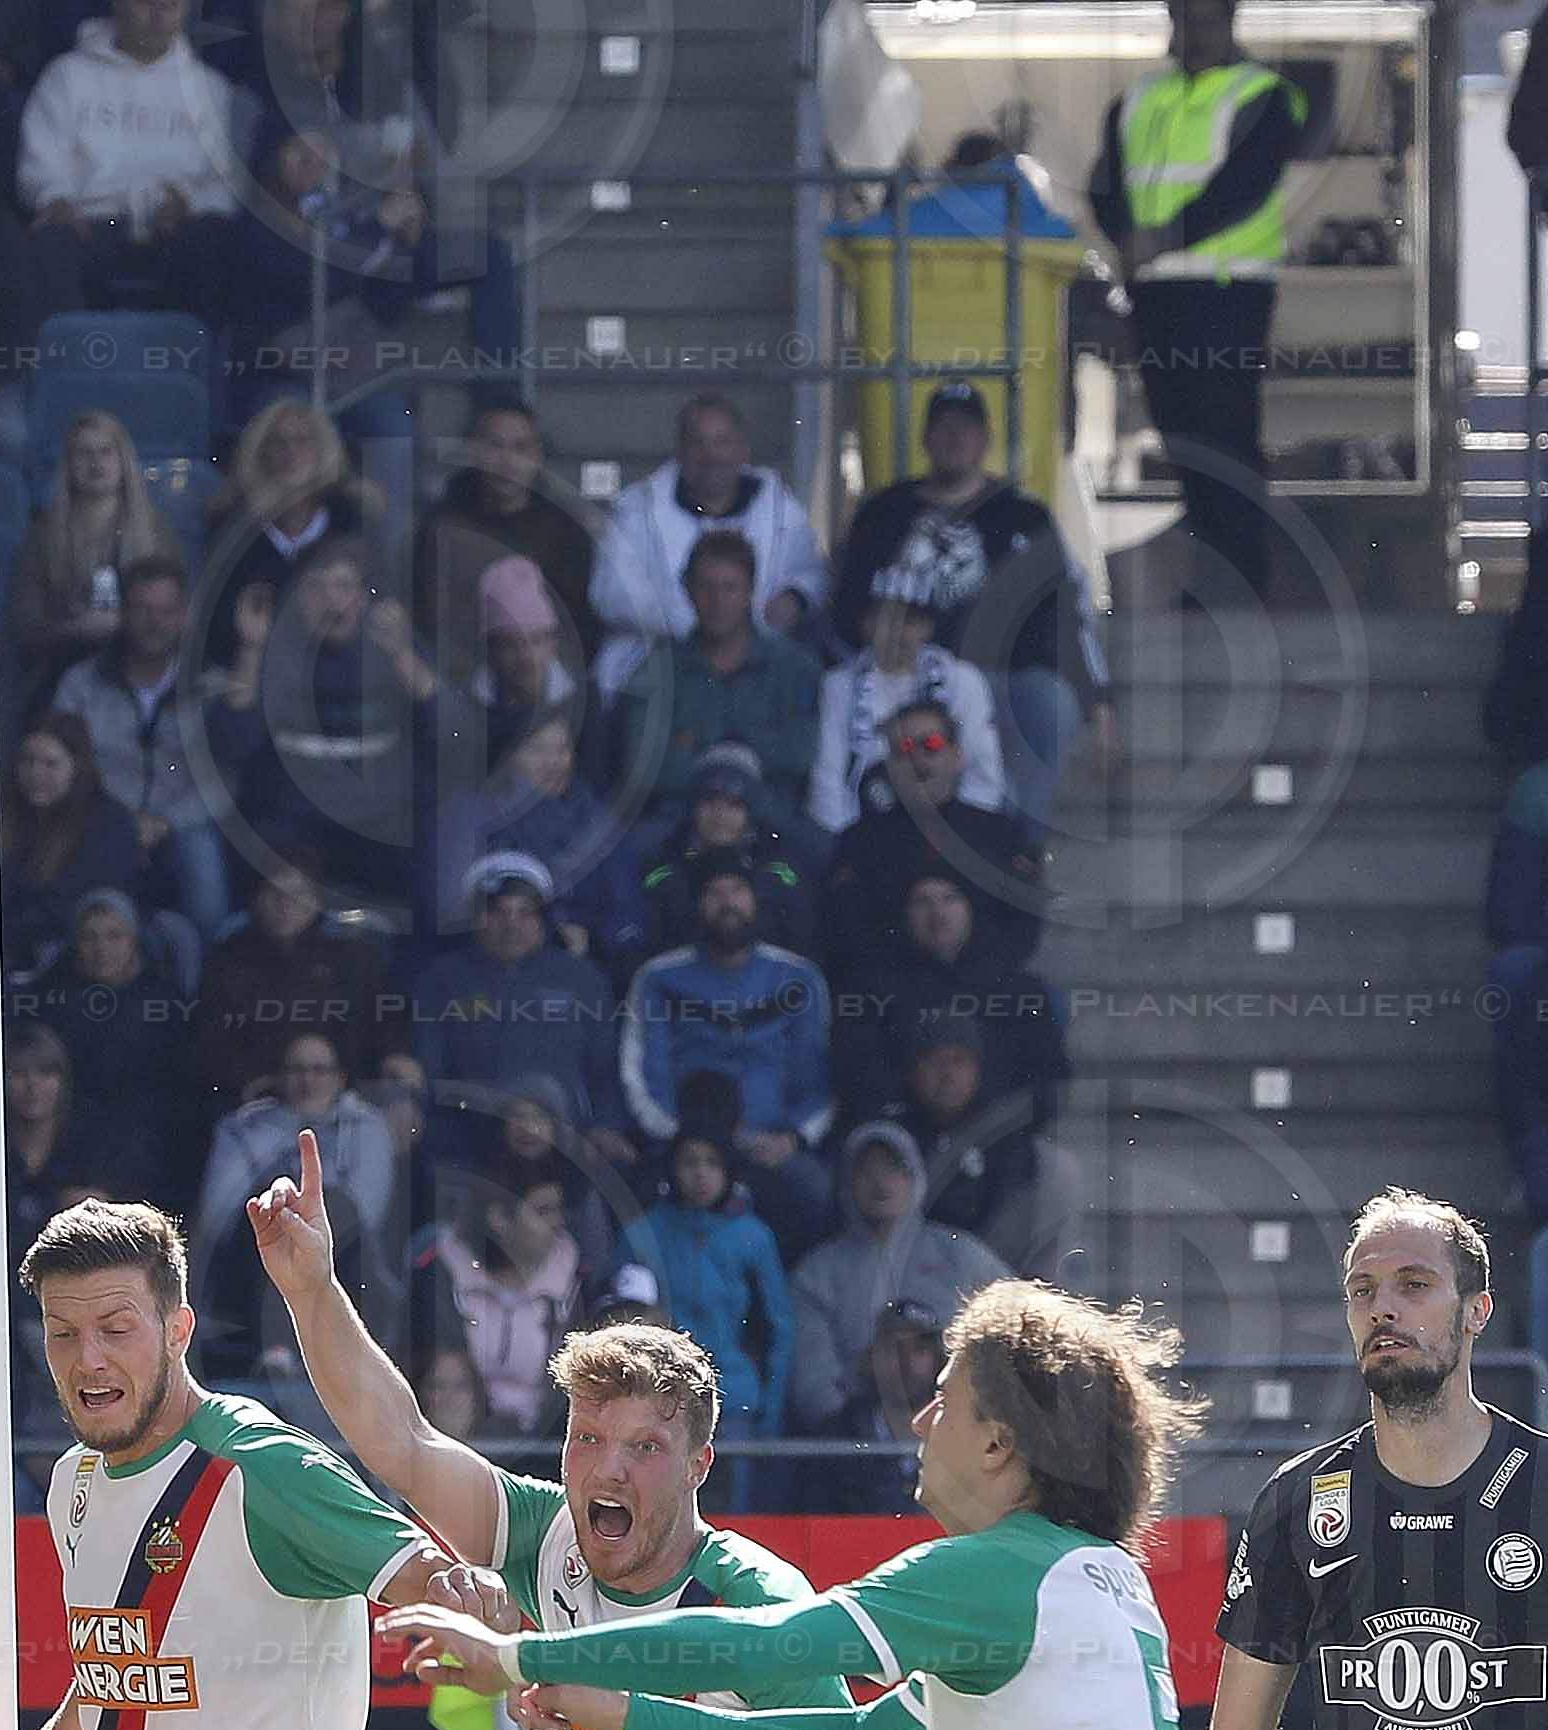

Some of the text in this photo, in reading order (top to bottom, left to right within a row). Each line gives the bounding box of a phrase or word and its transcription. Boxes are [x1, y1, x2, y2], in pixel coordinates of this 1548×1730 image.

[1483, 1450, 1525, 1506] PUNTIGAMER
[1406, 1514, 1454, 1532] GRAWE
[70, 1615, 146, 1655] WIEN
[1374, 1610, 1472, 1635] PUNTIGAMER
[74, 1663, 190, 1705] NERGIE
